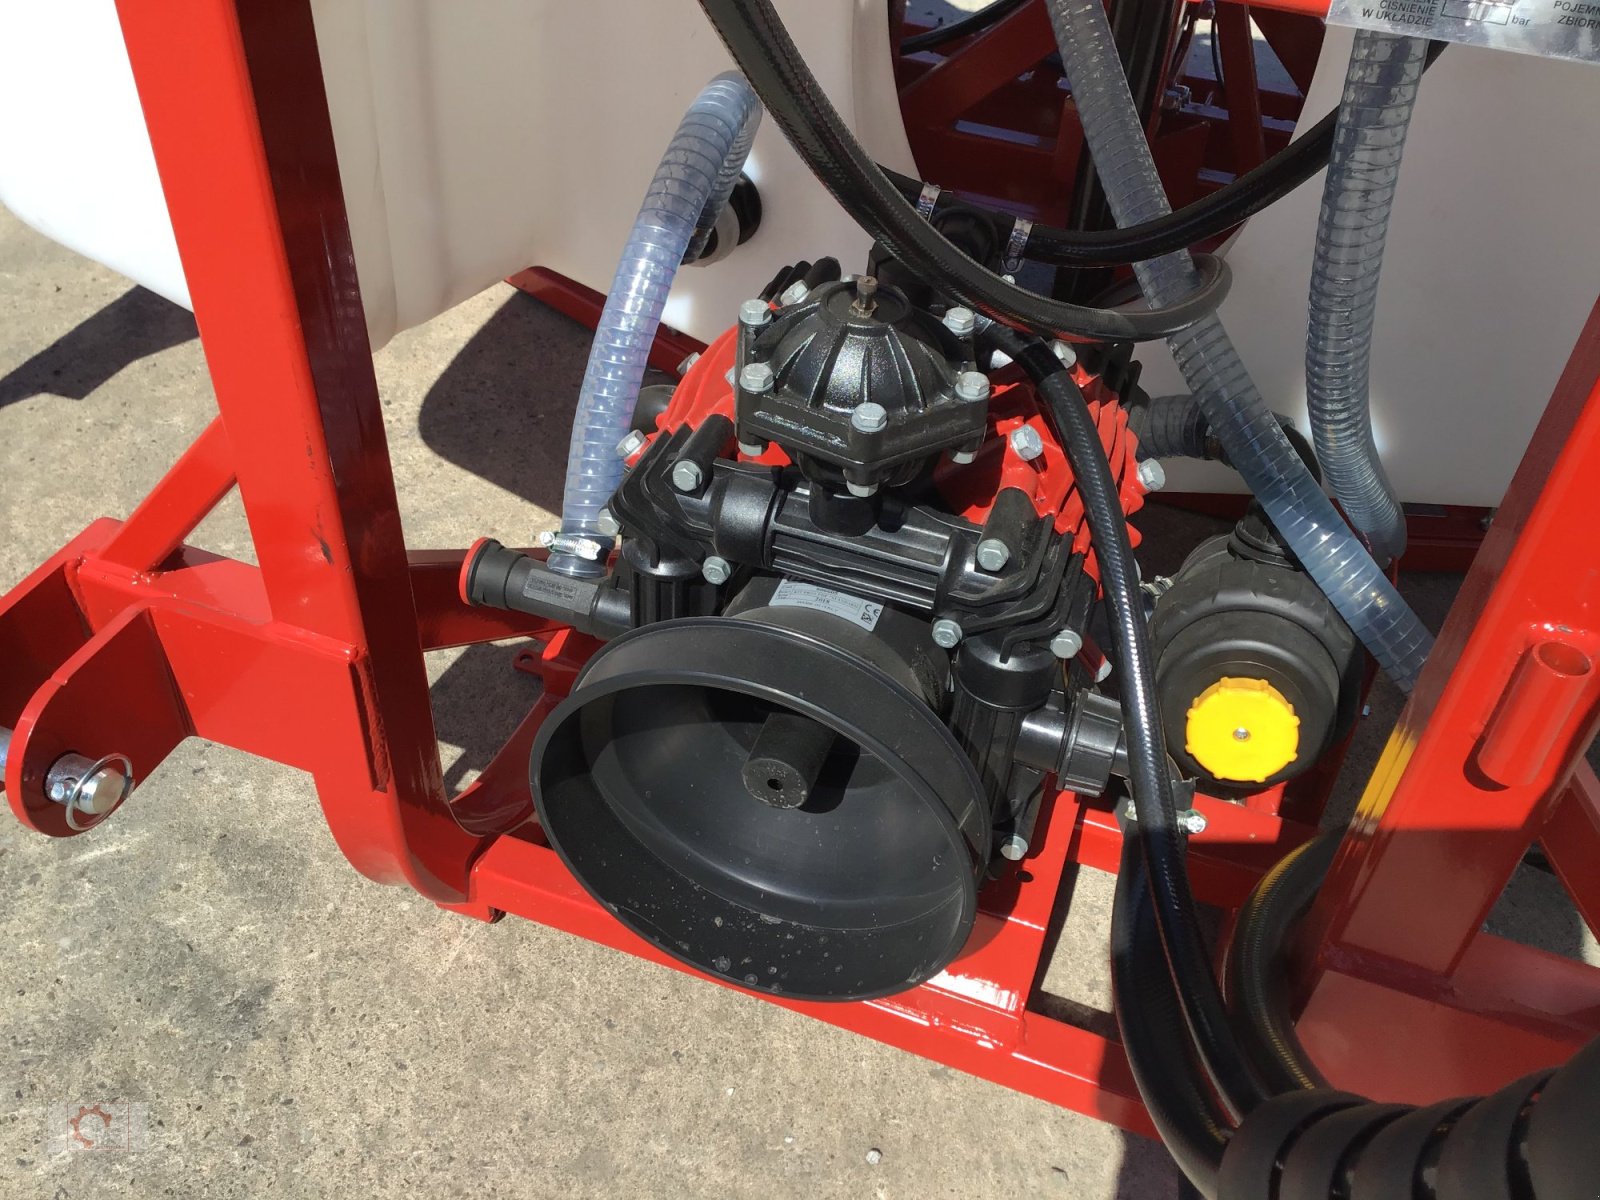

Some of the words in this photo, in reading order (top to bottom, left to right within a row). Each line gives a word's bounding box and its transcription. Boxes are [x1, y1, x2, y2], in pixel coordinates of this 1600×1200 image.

[1363, 8, 1374, 18] W
[1376, 11, 1435, 26] UKŁADZIE
[1512, 14, 1531, 28] bar
